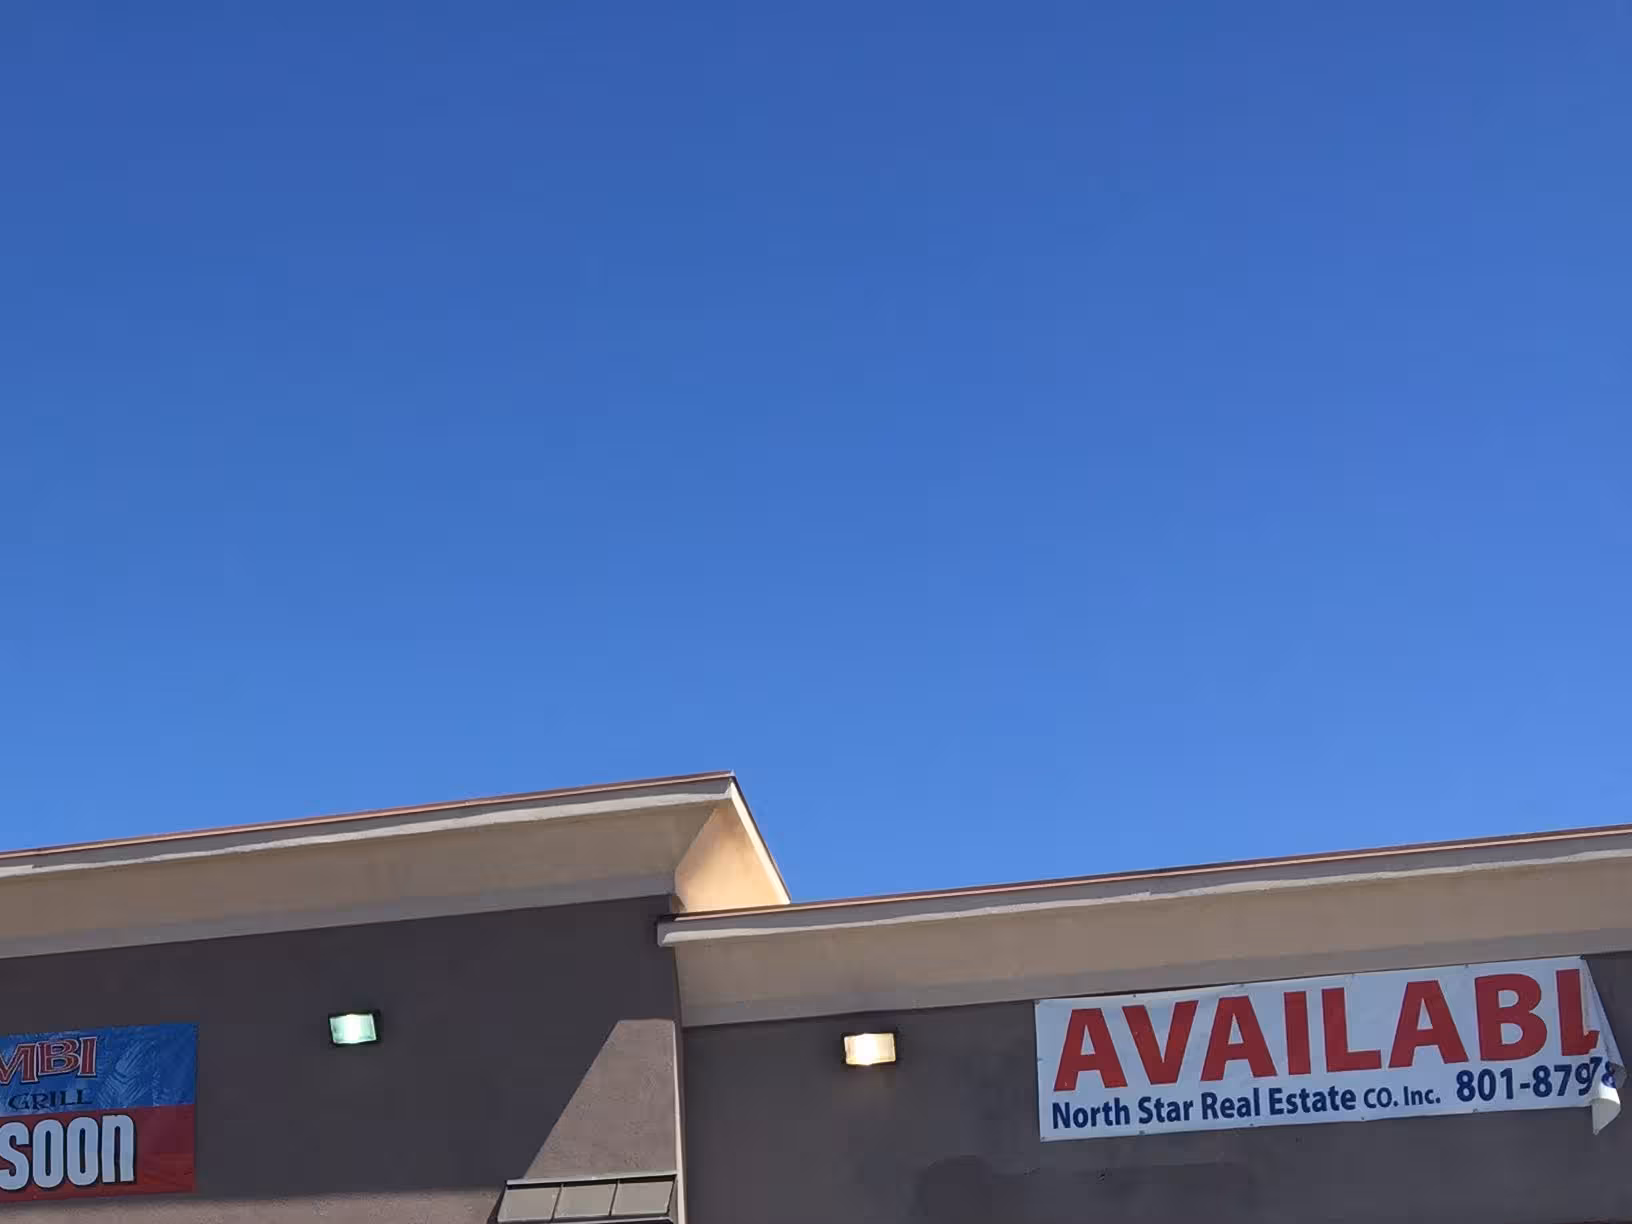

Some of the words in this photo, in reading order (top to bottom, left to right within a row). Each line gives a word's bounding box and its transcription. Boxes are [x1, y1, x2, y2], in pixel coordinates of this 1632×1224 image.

[1053, 968, 1601, 1092] AVAILABL
[8, 1089, 95, 1112] GRILL
[1052, 1099, 1131, 1129] North
[1138, 1096, 1194, 1124] Star
[1201, 1091, 1261, 1119] Real
[1269, 1085, 1357, 1115] Estate
[1403, 1084, 1442, 1106] Inc.
